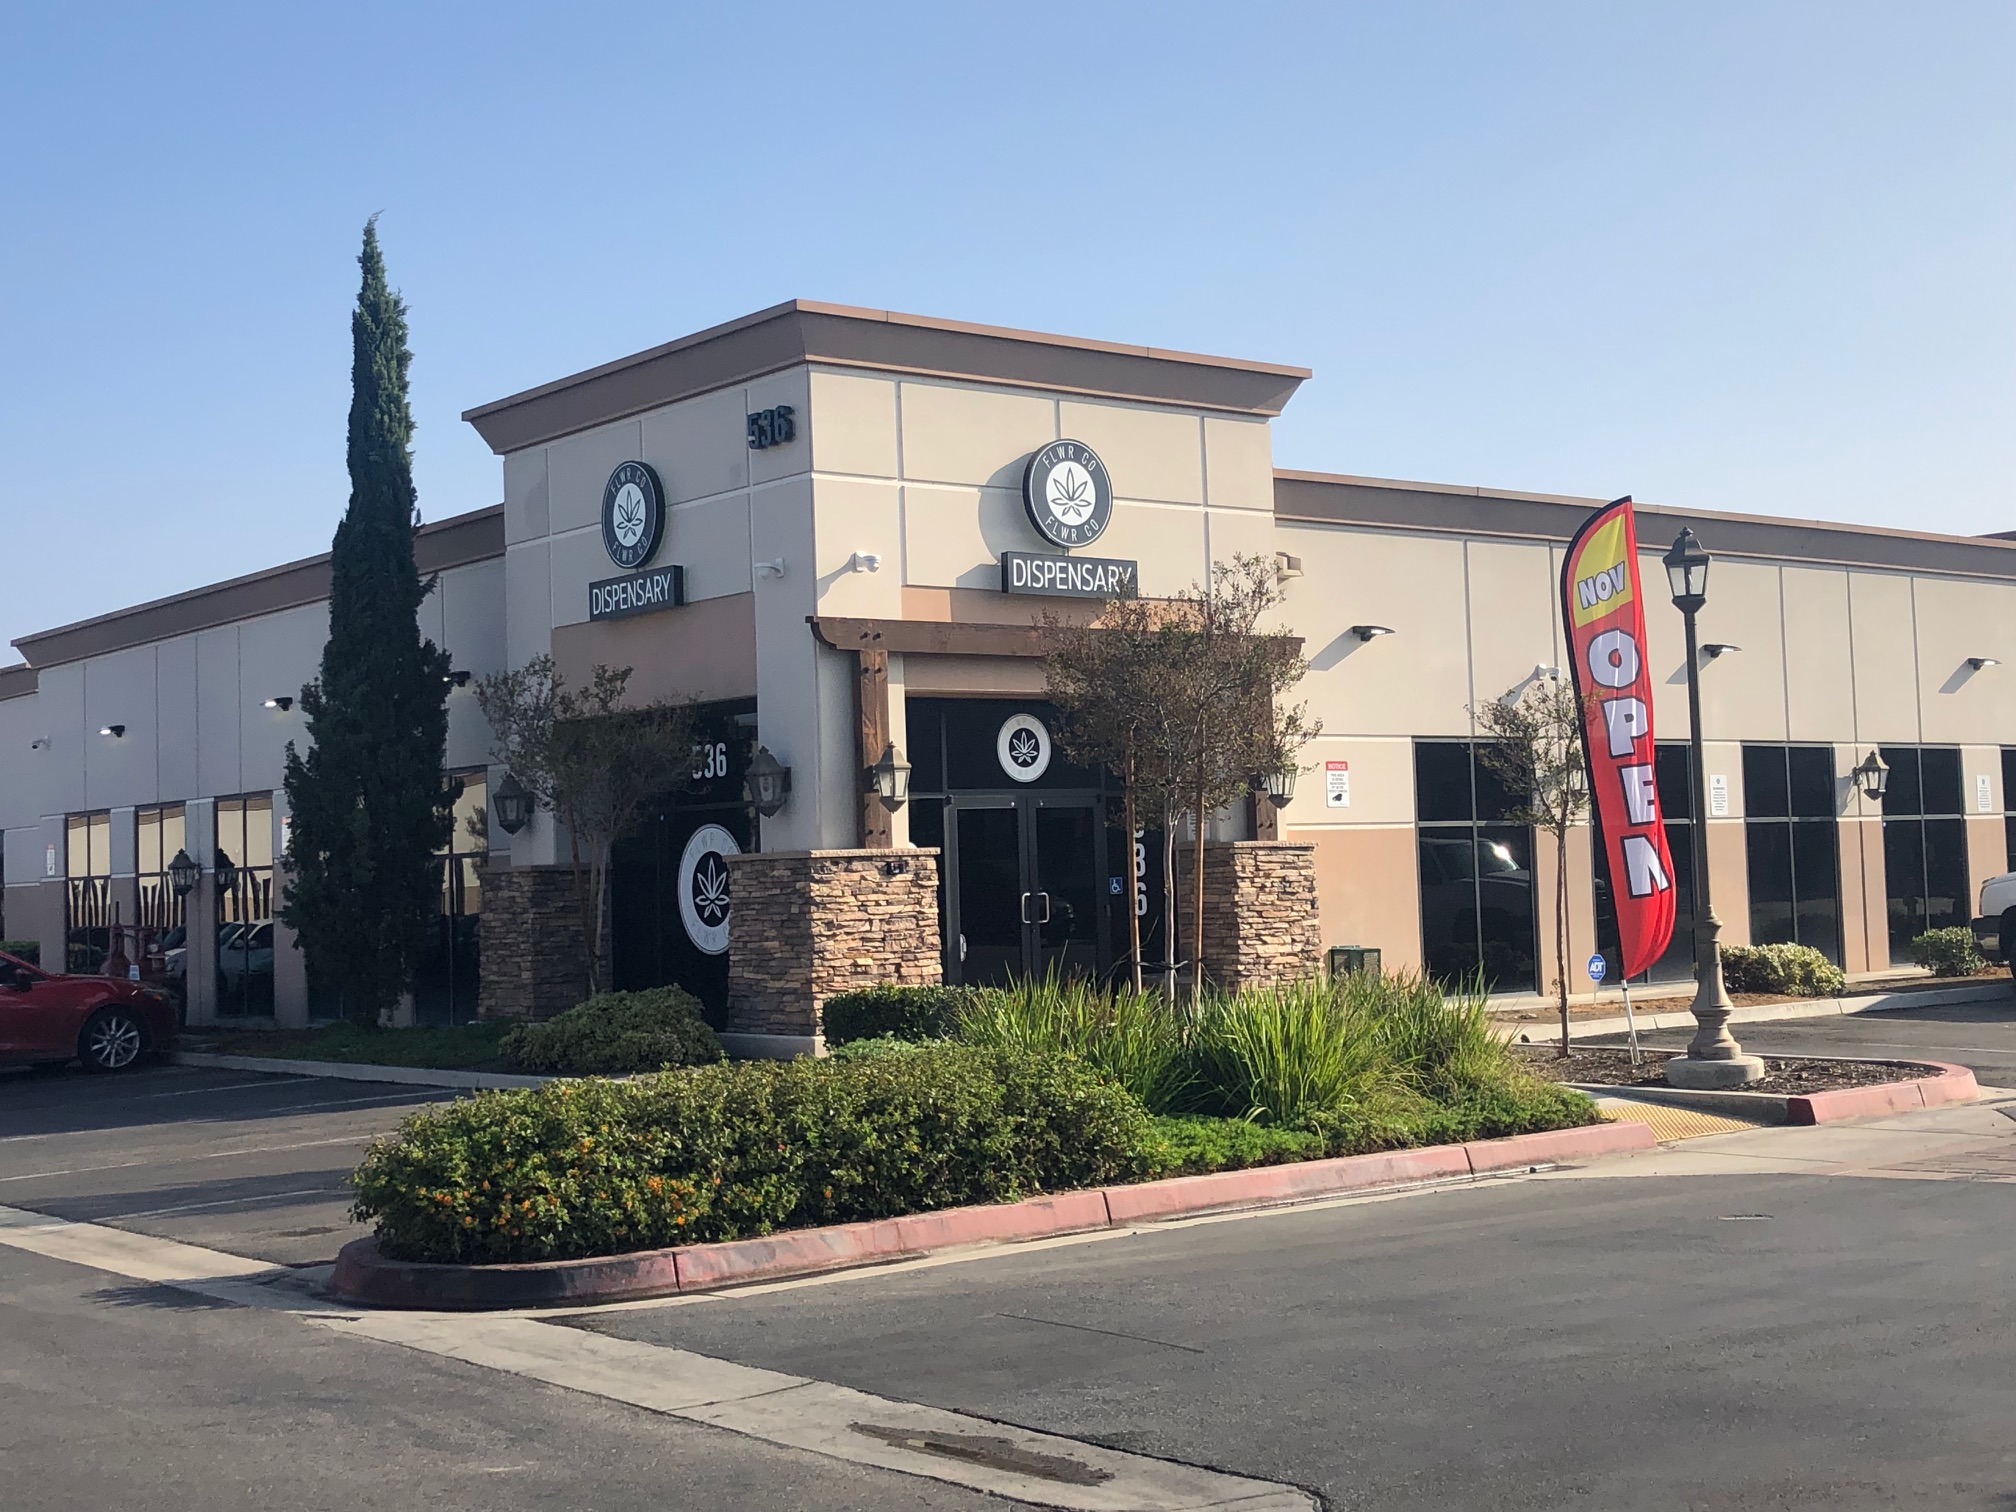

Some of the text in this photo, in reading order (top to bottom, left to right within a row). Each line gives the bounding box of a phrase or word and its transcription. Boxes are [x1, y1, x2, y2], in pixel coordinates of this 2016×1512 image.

[748, 405, 791, 450] 536
[1042, 445, 1097, 471] FLWR CO
[610, 467, 647, 495] FLWR CO
[1045, 516, 1099, 542] FLWR CO
[612, 536, 648, 562] FLWR CO
[1013, 558, 1132, 593] DISPENSARY
[592, 573, 671, 615] DISPENSARY
[1588, 628, 1672, 898] OPEN
[1590, 961, 1604, 973] ADT
